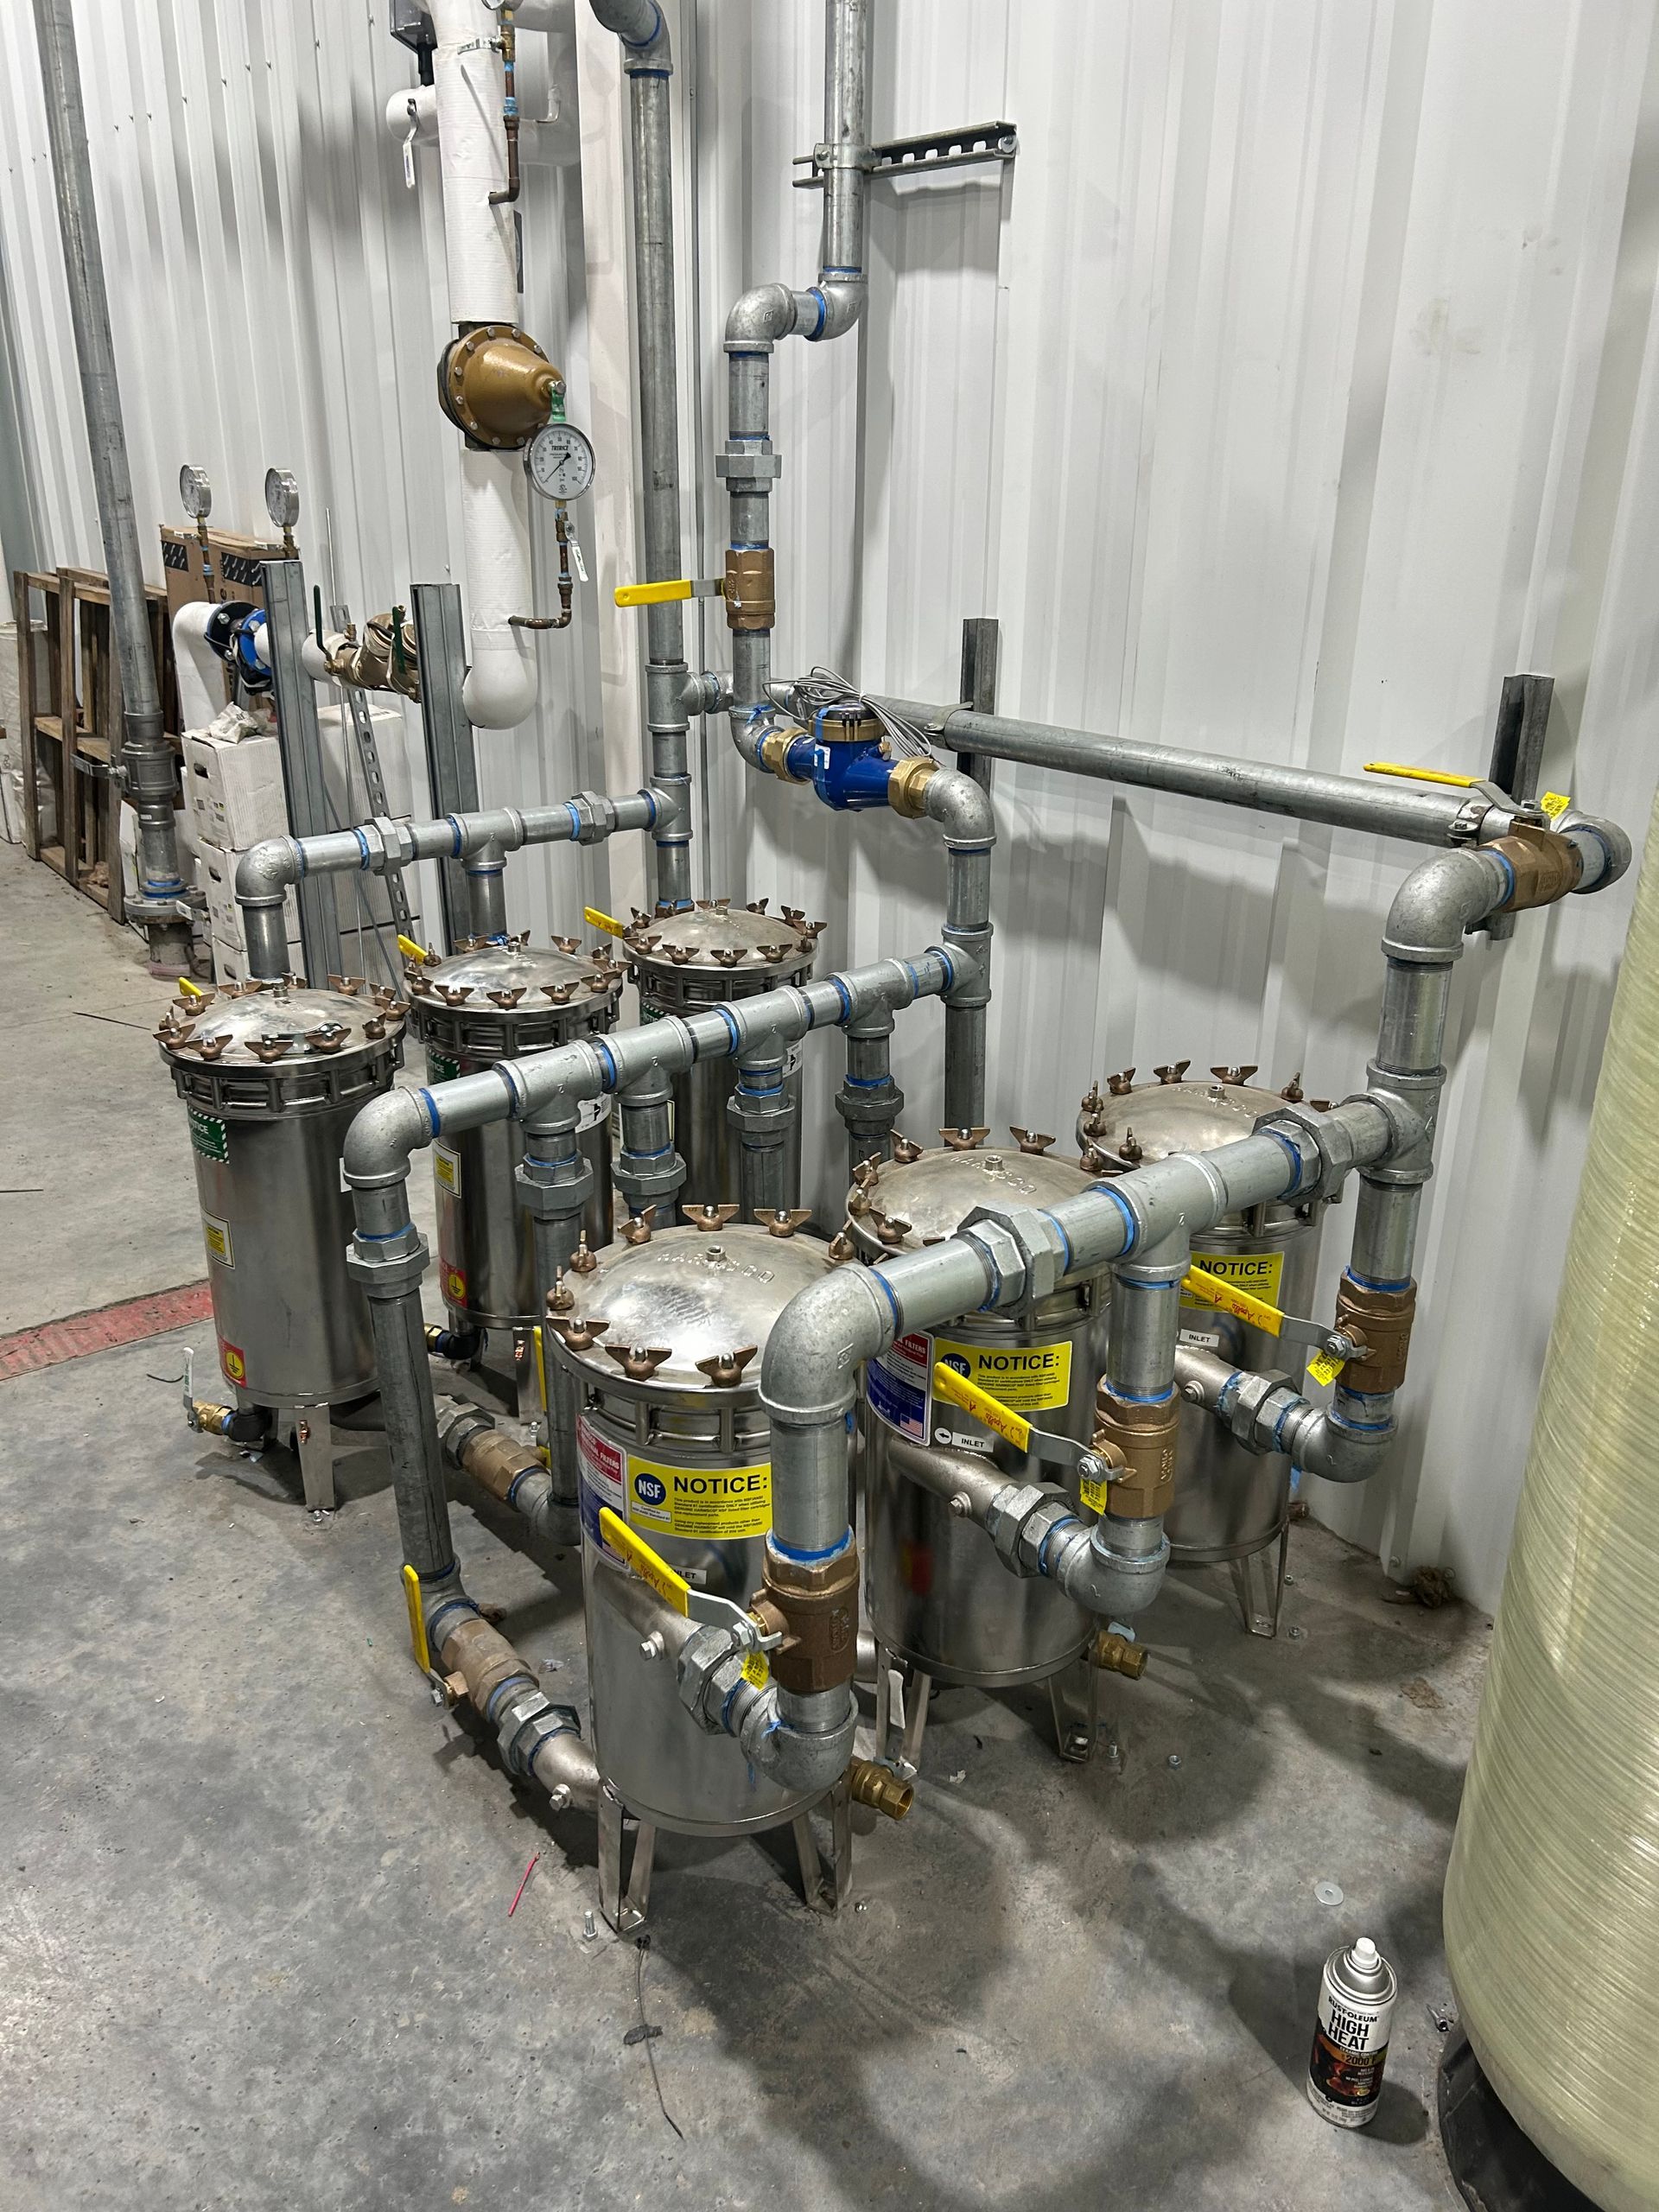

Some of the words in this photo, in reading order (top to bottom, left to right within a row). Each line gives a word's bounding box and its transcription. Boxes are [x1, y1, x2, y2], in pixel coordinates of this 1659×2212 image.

[1198, 1259, 1273, 1276] NOTICE:
[1188, 1333, 1211, 1343] INLET
[978, 1352, 1060, 1371] NOTICE:
[961, 1438, 985, 1448] INLET
[638, 1478, 661, 1499] NSF
[673, 1474, 768, 1494] NOTICE:
[1328, 1995, 1378, 2023] RUST-OLEUM
[1331, 2008, 1370, 2037] HIGH
[1328, 2020, 1370, 2051] HEAT
